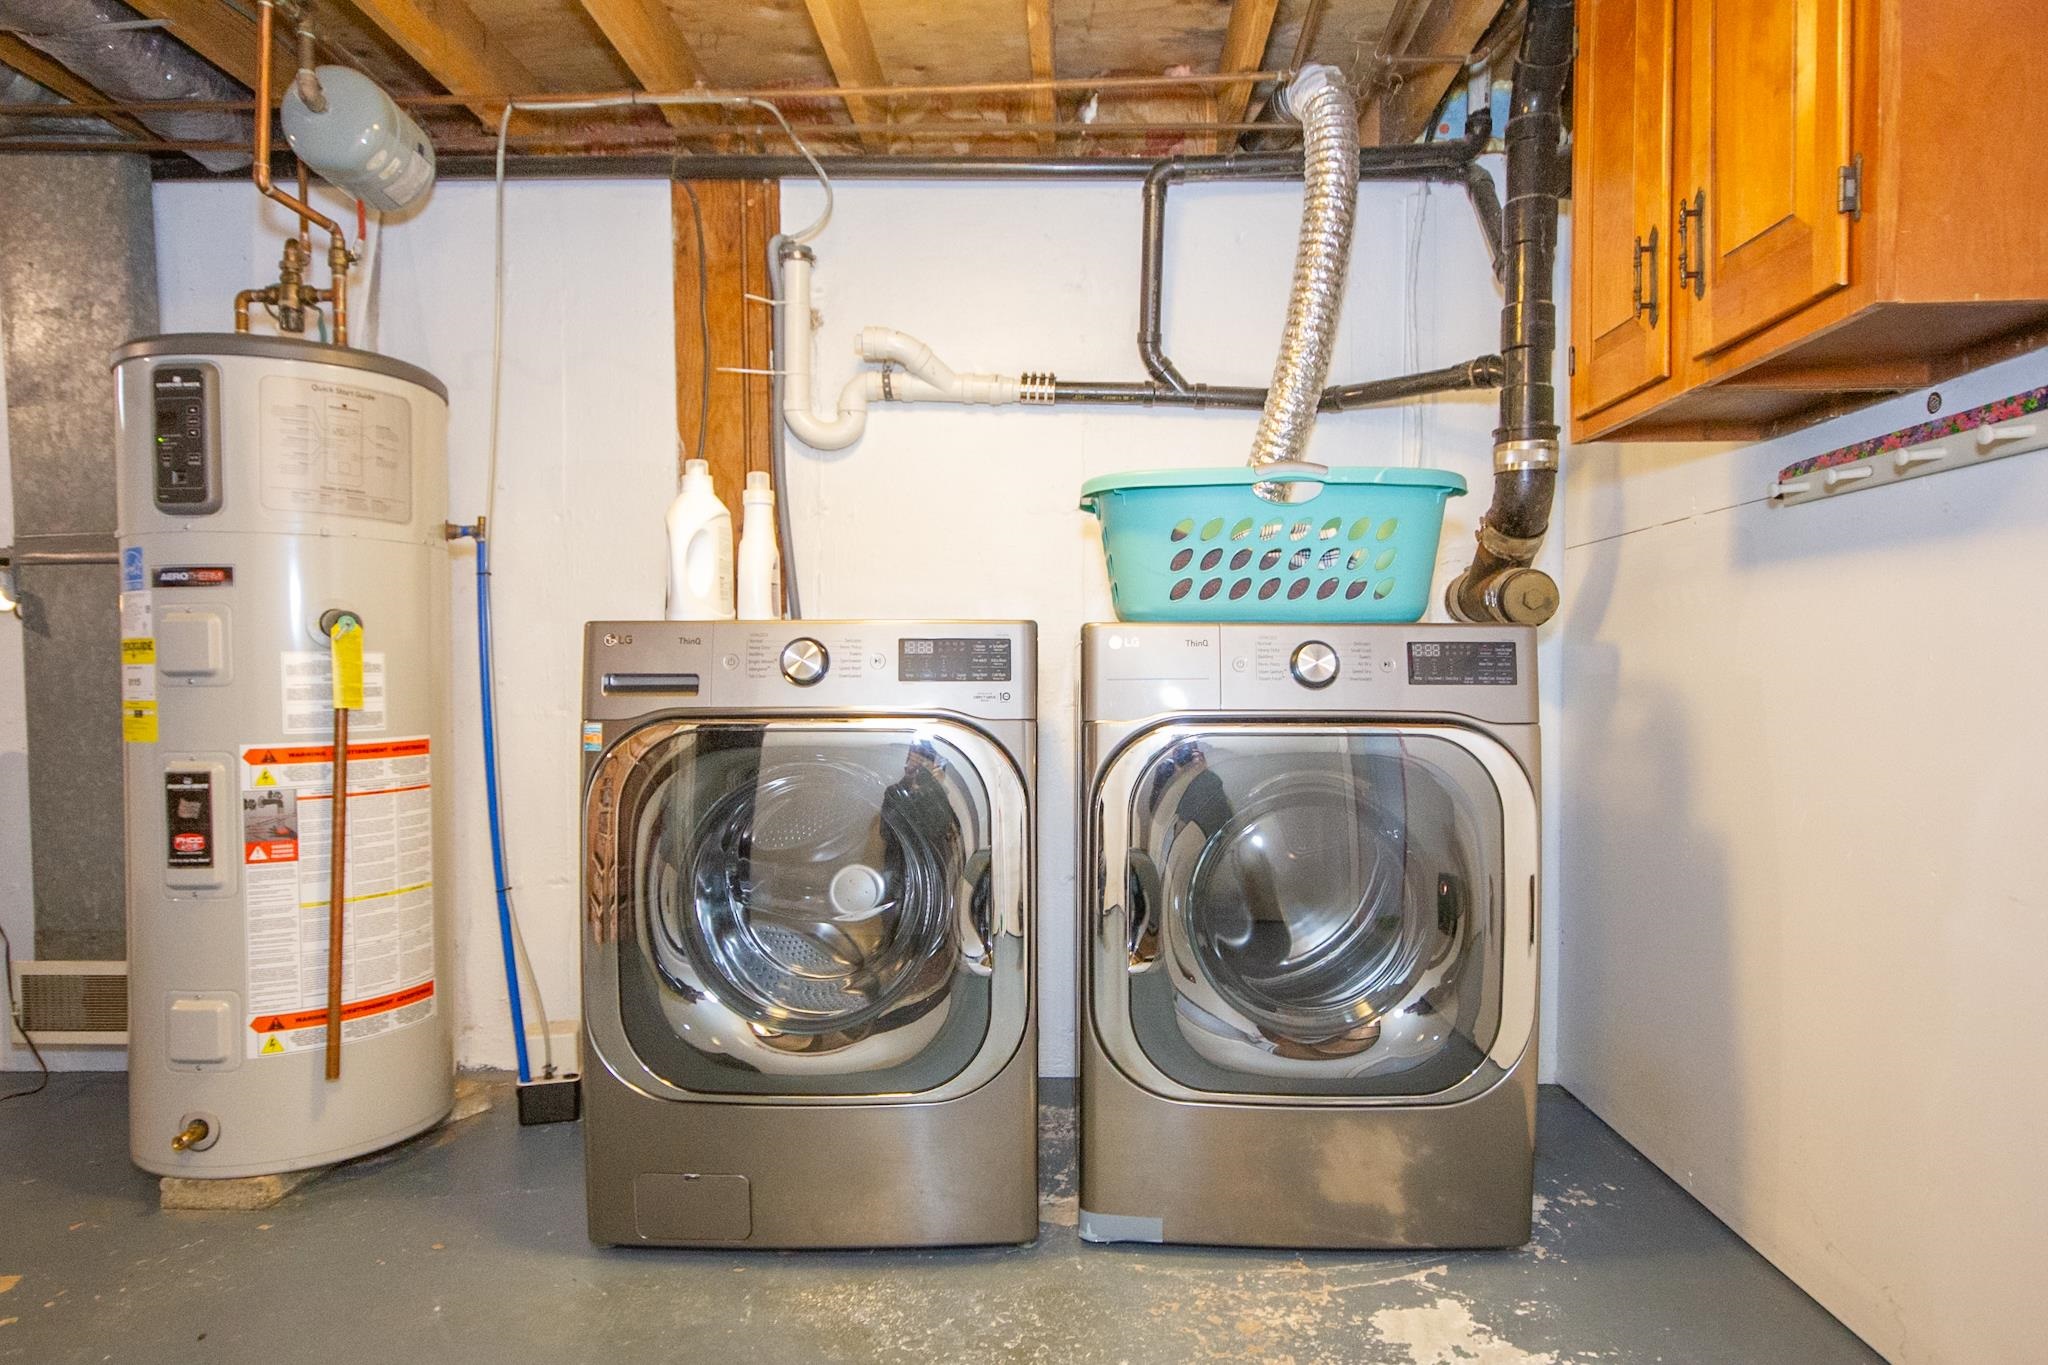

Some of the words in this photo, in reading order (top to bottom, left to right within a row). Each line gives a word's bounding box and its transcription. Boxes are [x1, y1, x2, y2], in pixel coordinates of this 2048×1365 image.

[311, 383, 334, 392] Quick
[336, 387, 354, 396] Start
[356, 390, 376, 400] Guide
[618, 634, 633, 645] LG
[678, 636, 702, 646] ThinQ
[1124, 636, 1140, 648] LG
[1185, 639, 1209, 647] ThinQ
